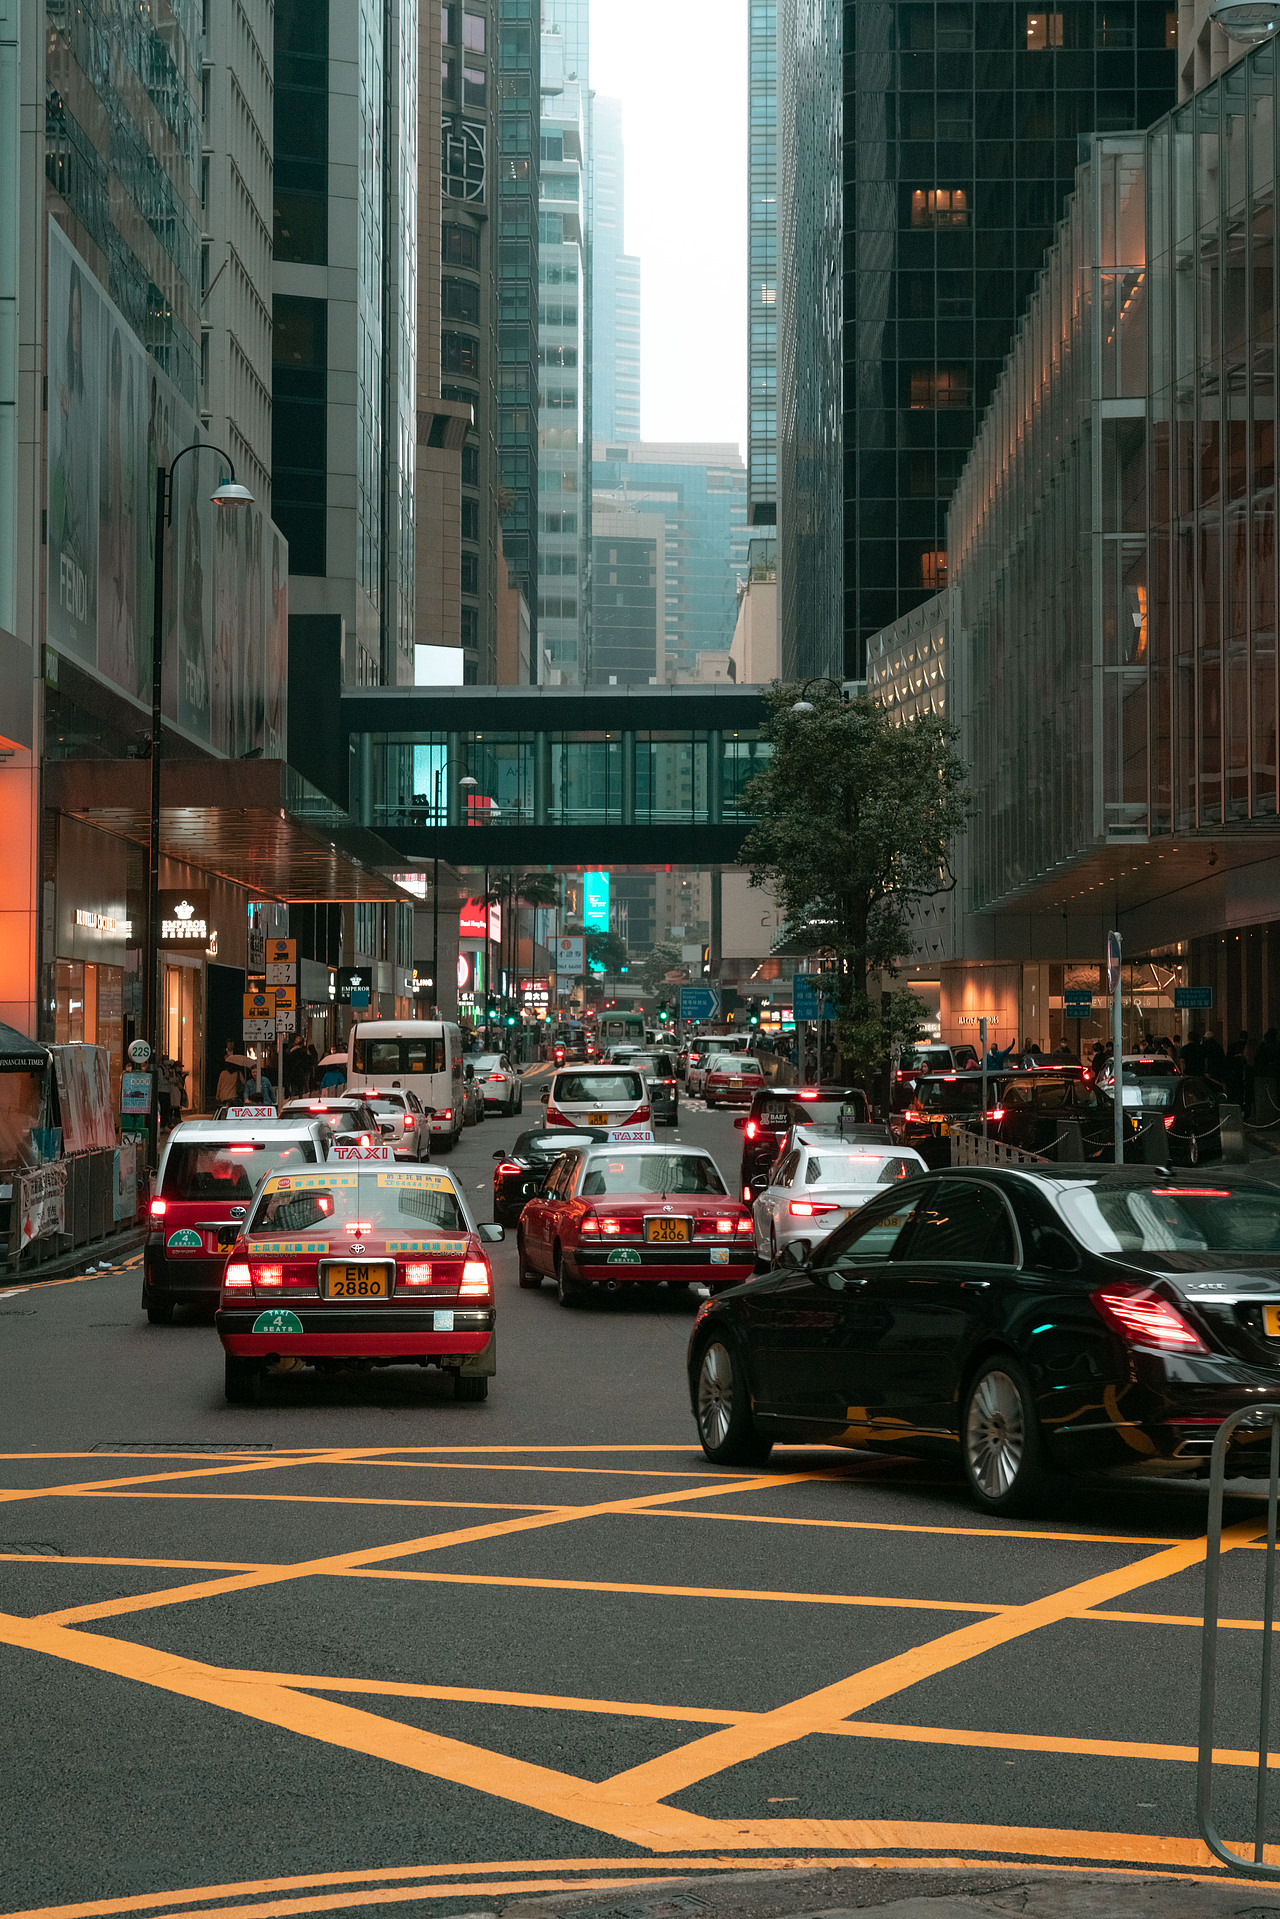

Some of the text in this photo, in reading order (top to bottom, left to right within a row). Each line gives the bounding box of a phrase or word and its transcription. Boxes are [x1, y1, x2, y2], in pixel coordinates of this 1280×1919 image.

[60, 551, 88, 625] FENDI
[162, 920, 206, 929] EMPEROR
[285, 964, 291, 972] 7
[285, 975, 291, 983] 7
[263, 1020, 269, 1028] 7
[284, 1023, 294, 1031] 12
[263, 1032, 274, 1040] 12
[132, 1047, 150, 1057] 22S
[231, 1107, 272, 1117] TAXI
[612, 1132, 651, 1141] TAXI
[334, 1147, 388, 1160] TAXI
[660, 1221, 676, 1231] UU
[652, 1230, 684, 1241] 2406
[220, 1245, 229, 1253] 2
[345, 1267, 369, 1281] EM
[333, 1281, 381, 1296] 2880
[273, 1316, 283, 1326] 4
